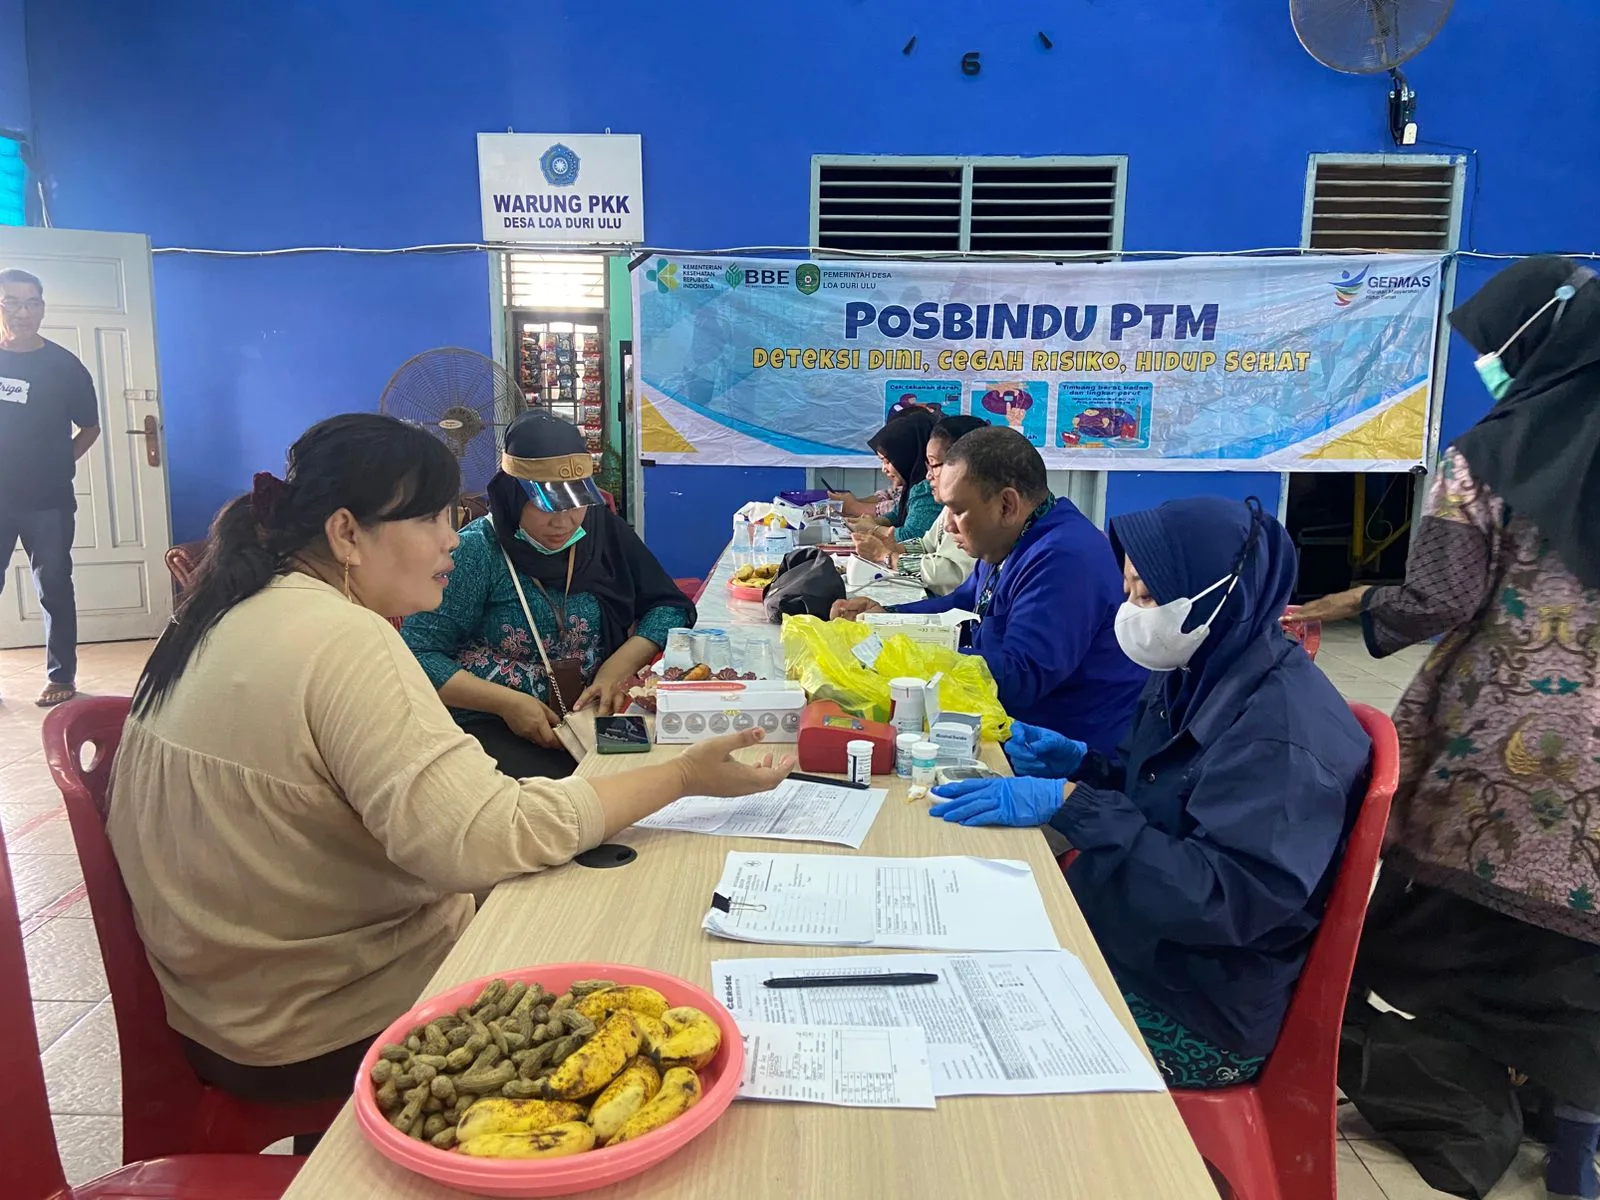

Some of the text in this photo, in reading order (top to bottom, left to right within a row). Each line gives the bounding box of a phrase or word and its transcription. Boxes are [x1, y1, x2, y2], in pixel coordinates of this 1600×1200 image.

[961, 52, 981, 76] 6
[493, 194, 630, 214] WARUNG PKK
[503, 217, 622, 229] DESA LOA DURI ULU
[744, 269, 790, 285] BBE
[823, 271, 871, 279] PEMERINTAH
[1367, 275, 1431, 289] GERMAS
[860, 282, 877, 290] ULU
[845, 301, 1220, 341] POSBINDU PTM
[1031, 350, 1127, 374] RISIKO,
[1134, 350, 1217, 372] HIDUP
